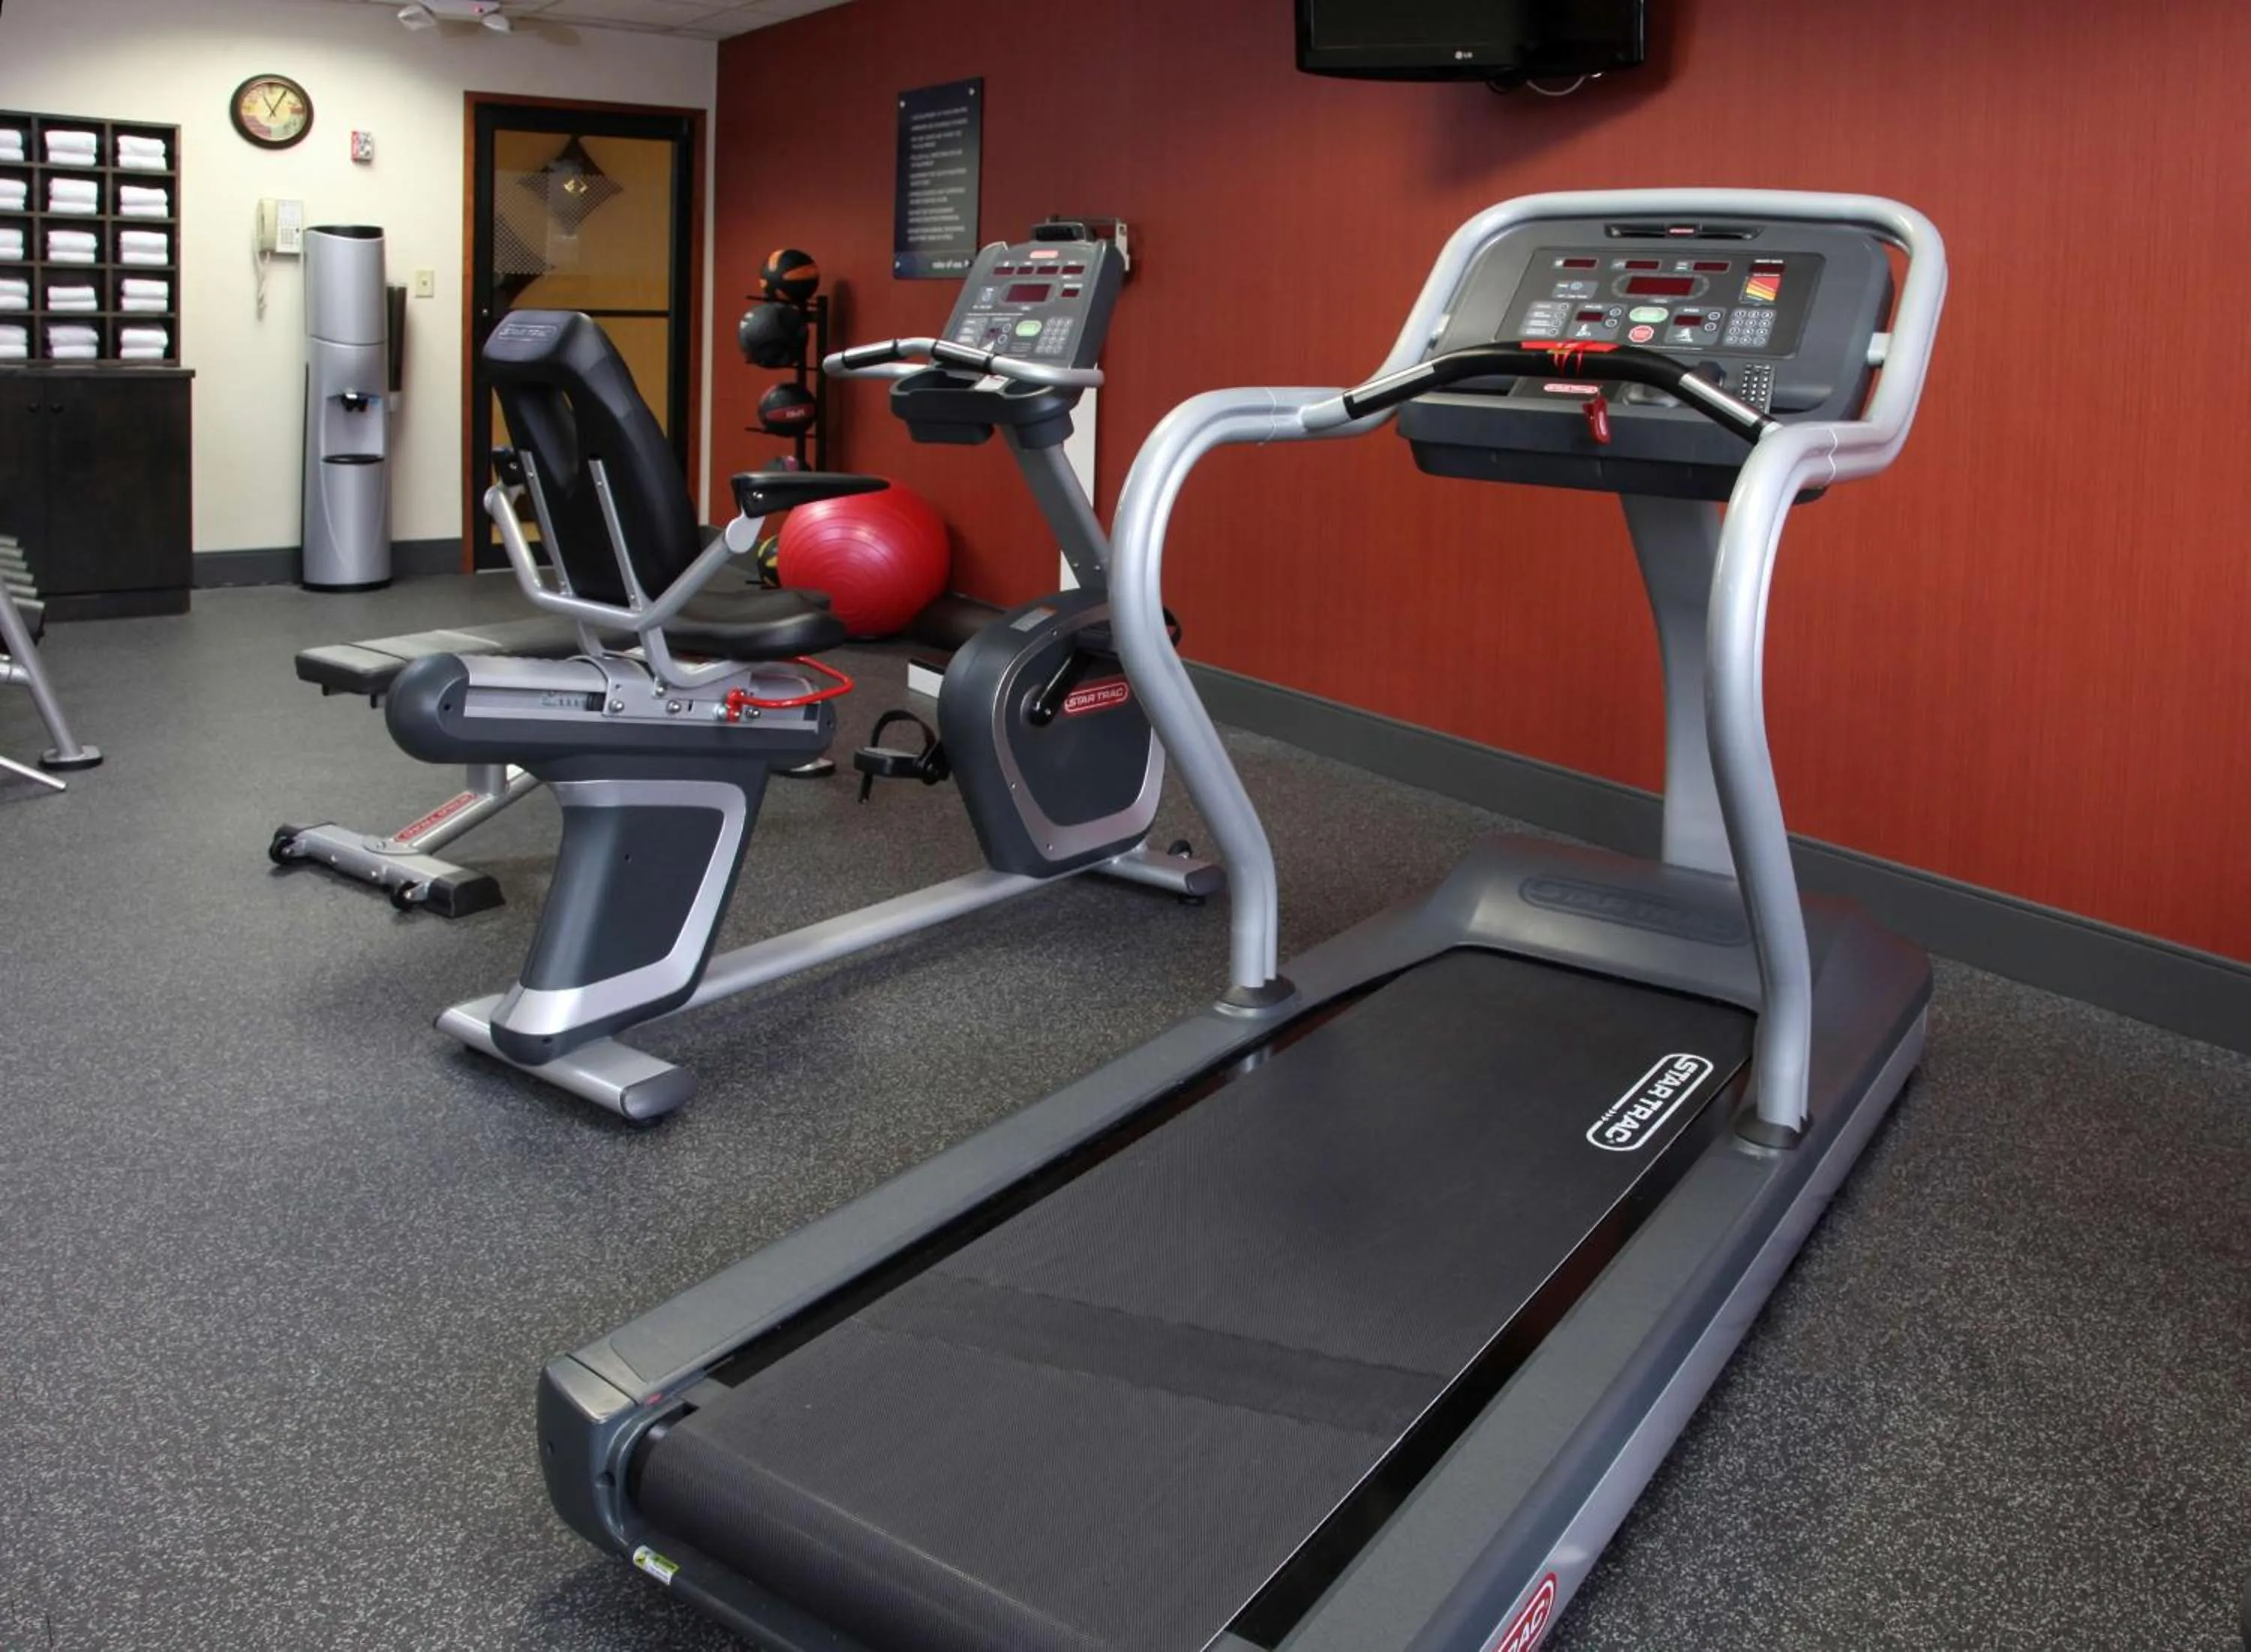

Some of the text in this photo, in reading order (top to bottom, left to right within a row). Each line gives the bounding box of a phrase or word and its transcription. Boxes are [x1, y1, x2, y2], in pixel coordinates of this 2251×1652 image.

[1068, 687, 1123, 707] STAR TRAC
[1604, 1056, 1700, 1143] STAR TRAC
